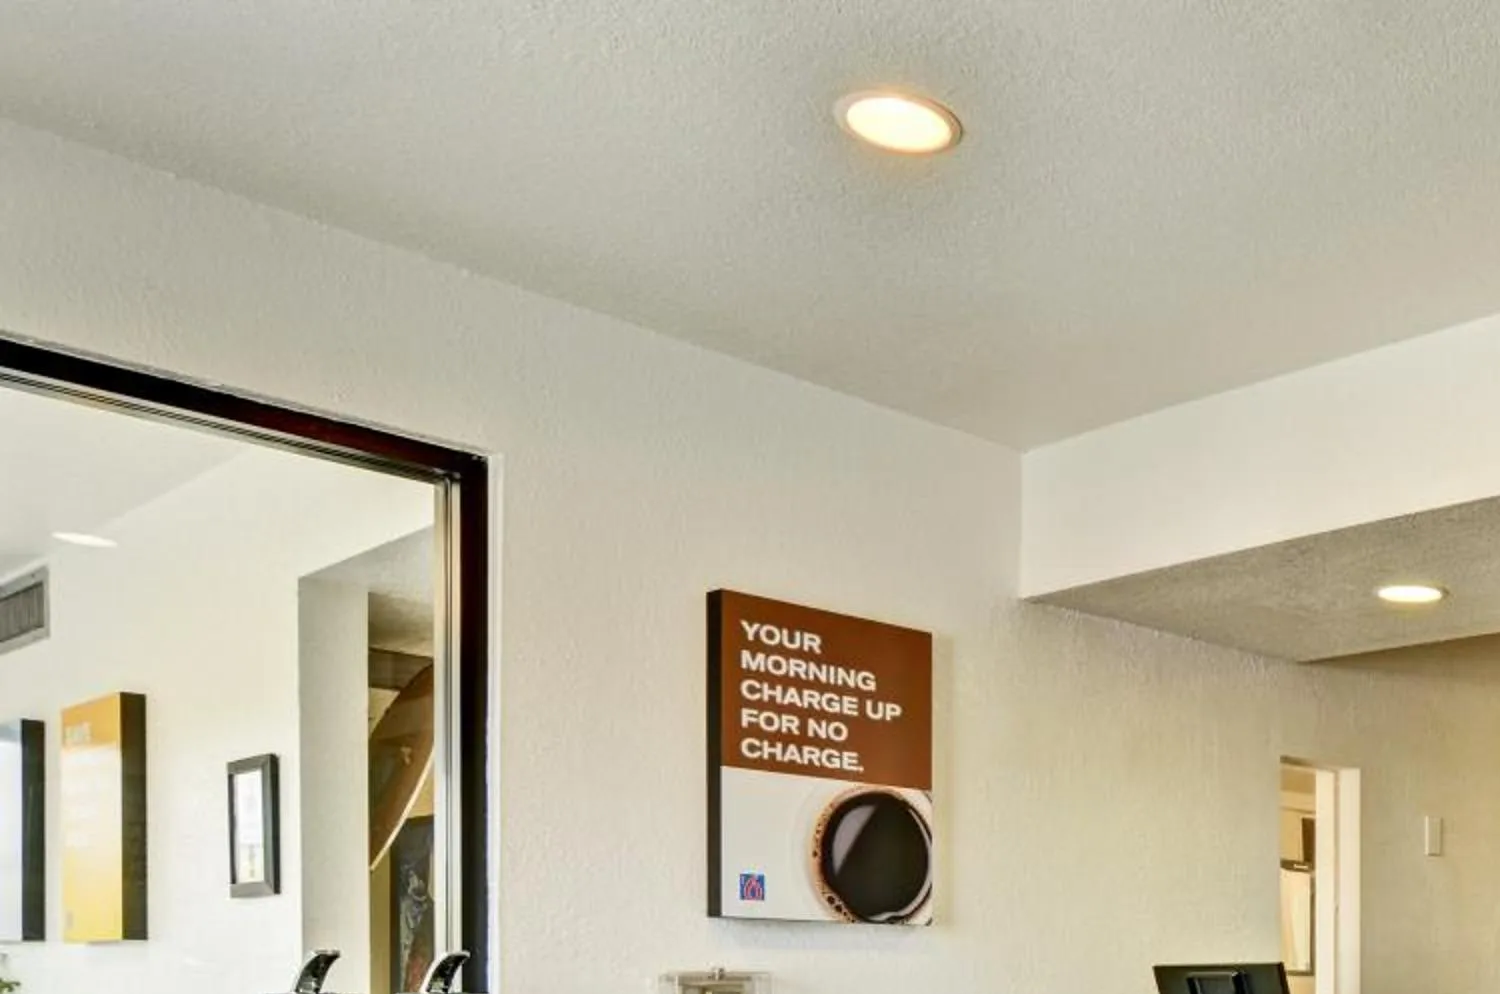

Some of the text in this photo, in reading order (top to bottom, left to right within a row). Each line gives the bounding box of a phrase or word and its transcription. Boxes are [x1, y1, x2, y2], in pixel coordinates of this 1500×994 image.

[740, 619, 822, 653] YOUR
[740, 650, 877, 692] MORNING
[740, 680, 902, 721] CHARGE UP
[740, 708, 848, 742] FOR NO
[740, 737, 865, 772] CHARGE.
